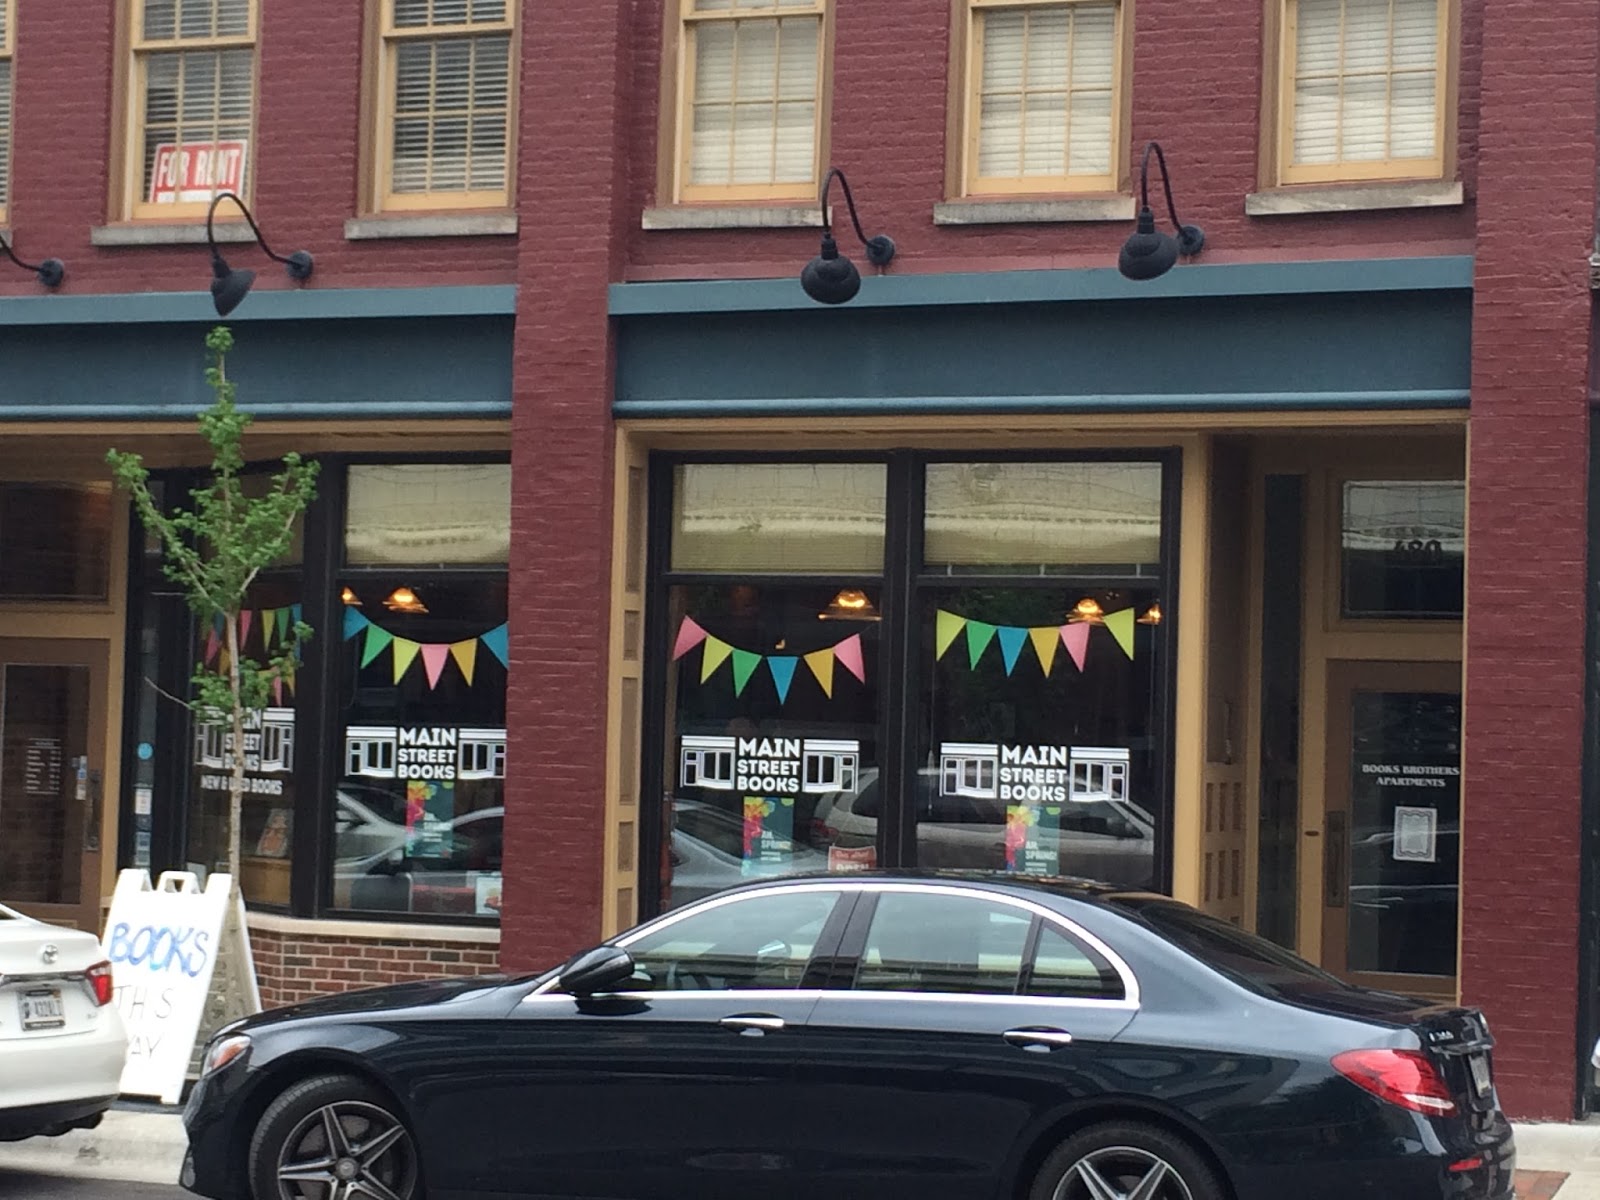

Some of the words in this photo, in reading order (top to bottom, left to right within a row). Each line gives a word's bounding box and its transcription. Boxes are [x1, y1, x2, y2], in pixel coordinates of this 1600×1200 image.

[157, 151, 190, 187] FOR
[194, 149, 240, 185] RENT
[399, 727, 456, 746] MAIN
[398, 748, 457, 764] STREET
[738, 736, 801, 758] MAIN
[1001, 743, 1068, 766] MAIN
[398, 764, 455, 780] BOOKS
[736, 758, 800, 776] STREET
[1000, 766, 1068, 785] STREET
[1362, 764, 1400, 773] BOOKS
[1402, 766, 1459, 775] BROTHERS
[251, 777, 284, 795] BOOKS
[736, 775, 800, 792] BOOKS
[1376, 777, 1446, 787] APARTMENTS
[1000, 784, 1066, 802] BOOKS
[109, 922, 209, 978] BOOKS
